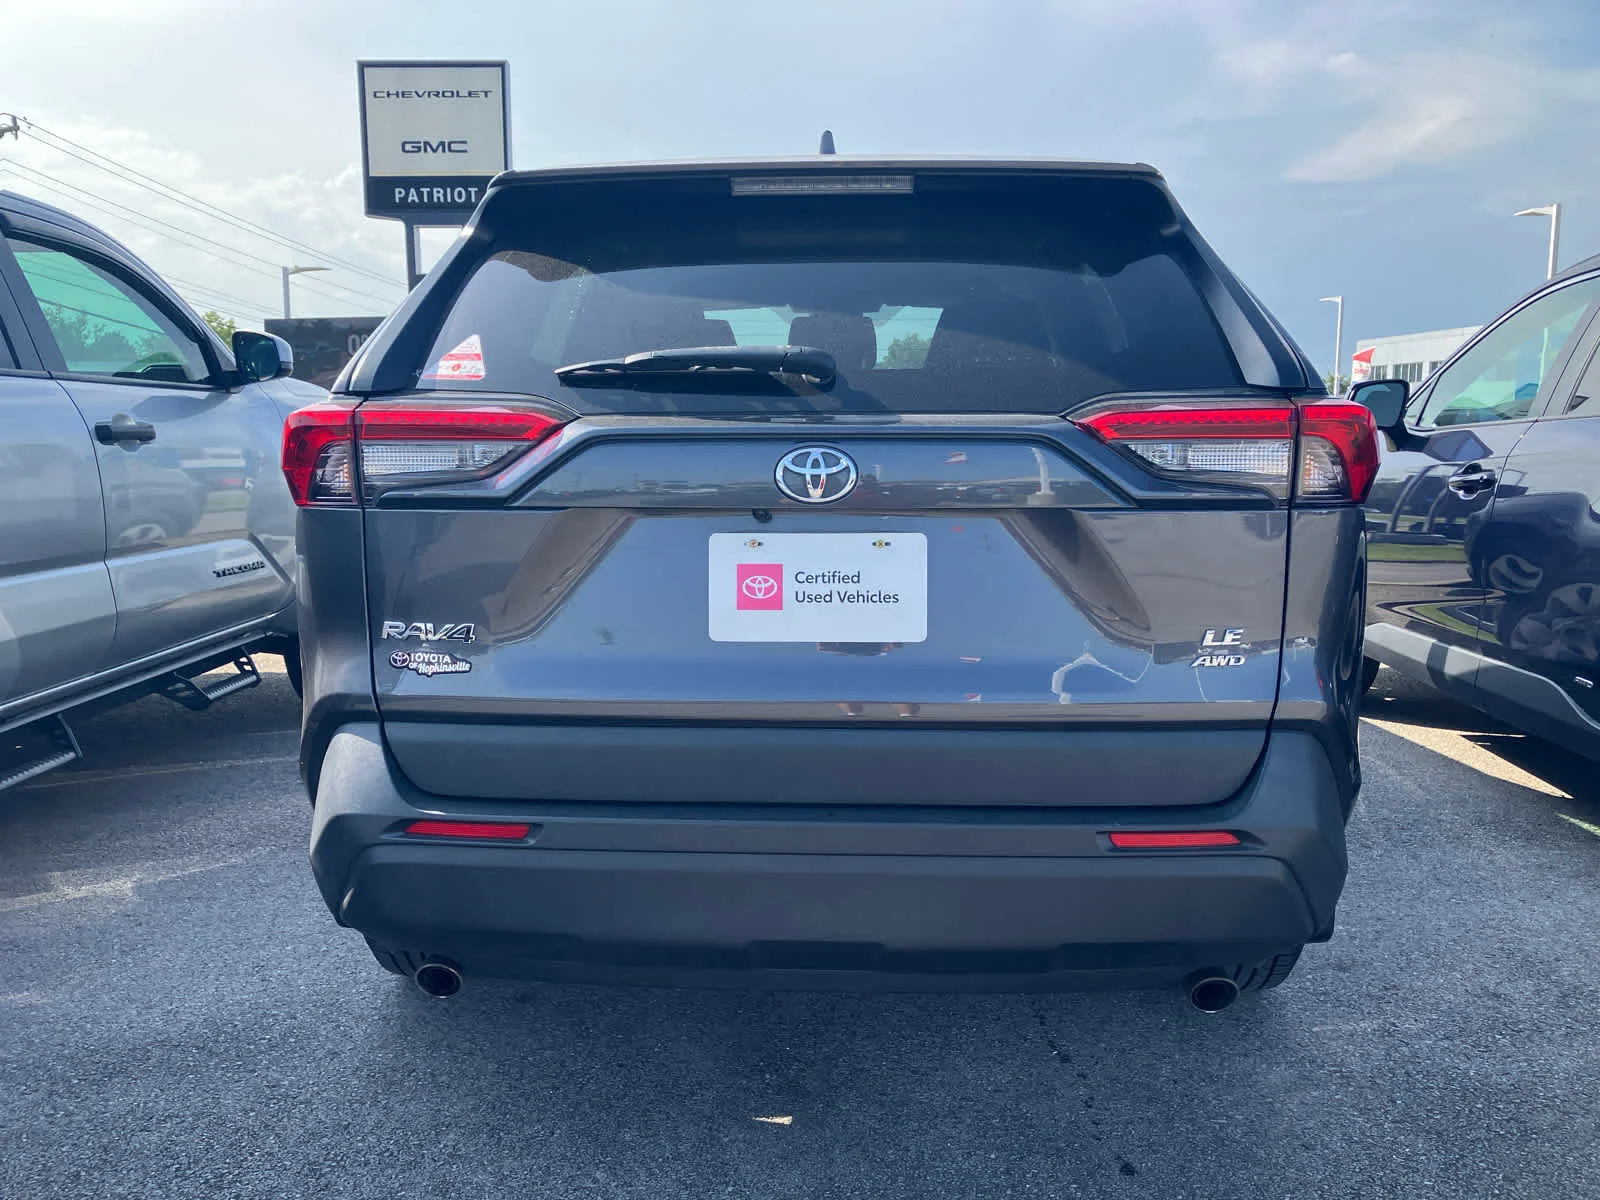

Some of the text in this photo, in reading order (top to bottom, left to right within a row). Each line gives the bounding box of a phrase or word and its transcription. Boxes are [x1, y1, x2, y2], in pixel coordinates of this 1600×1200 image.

[373, 90, 493, 98] CHEVROLET
[401, 140, 468, 153] GMC
[394, 187, 478, 203] PATRIOT
[794, 571, 861, 584] Certified
[794, 590, 900, 604] Used Vehicles
[381, 621, 476, 644] RAV4
[1202, 629, 1244, 646] LE
[410, 653, 451, 663] TOYOTA
[1190, 654, 1246, 667] AWD
[418, 661, 471, 675] Hopkinsville
